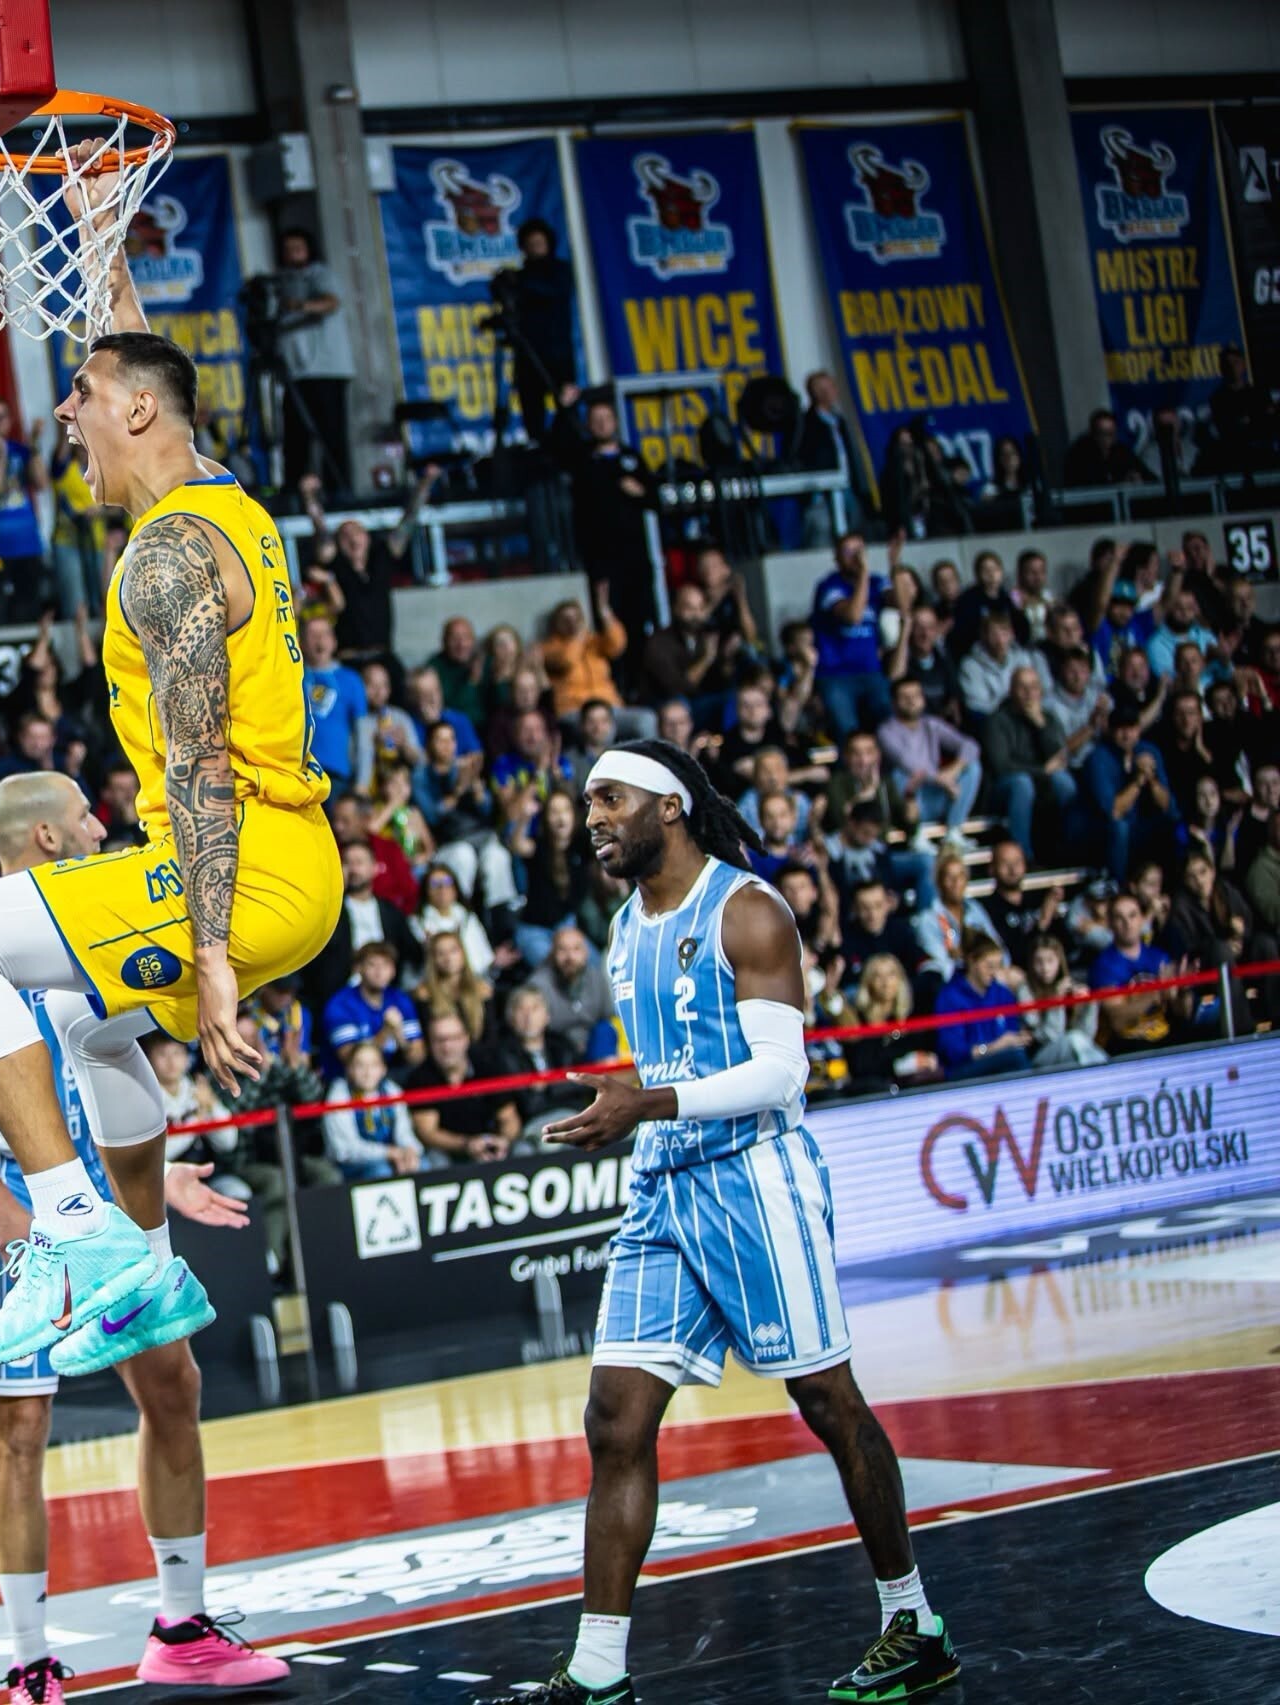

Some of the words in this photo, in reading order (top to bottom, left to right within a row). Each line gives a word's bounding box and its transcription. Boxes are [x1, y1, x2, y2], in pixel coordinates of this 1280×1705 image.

[1096, 245, 1200, 294] MISTRZ
[624, 290, 767, 374] WICE
[1122, 293, 1189, 347] LIGI
[851, 341, 1010, 416] MEDAL
[1227, 524, 1272, 574] 35
[673, 975, 699, 1022] 2
[1053, 1078, 1214, 1155] OSTRÓW
[1048, 1130, 1250, 1193] WIELKOPOLSKI
